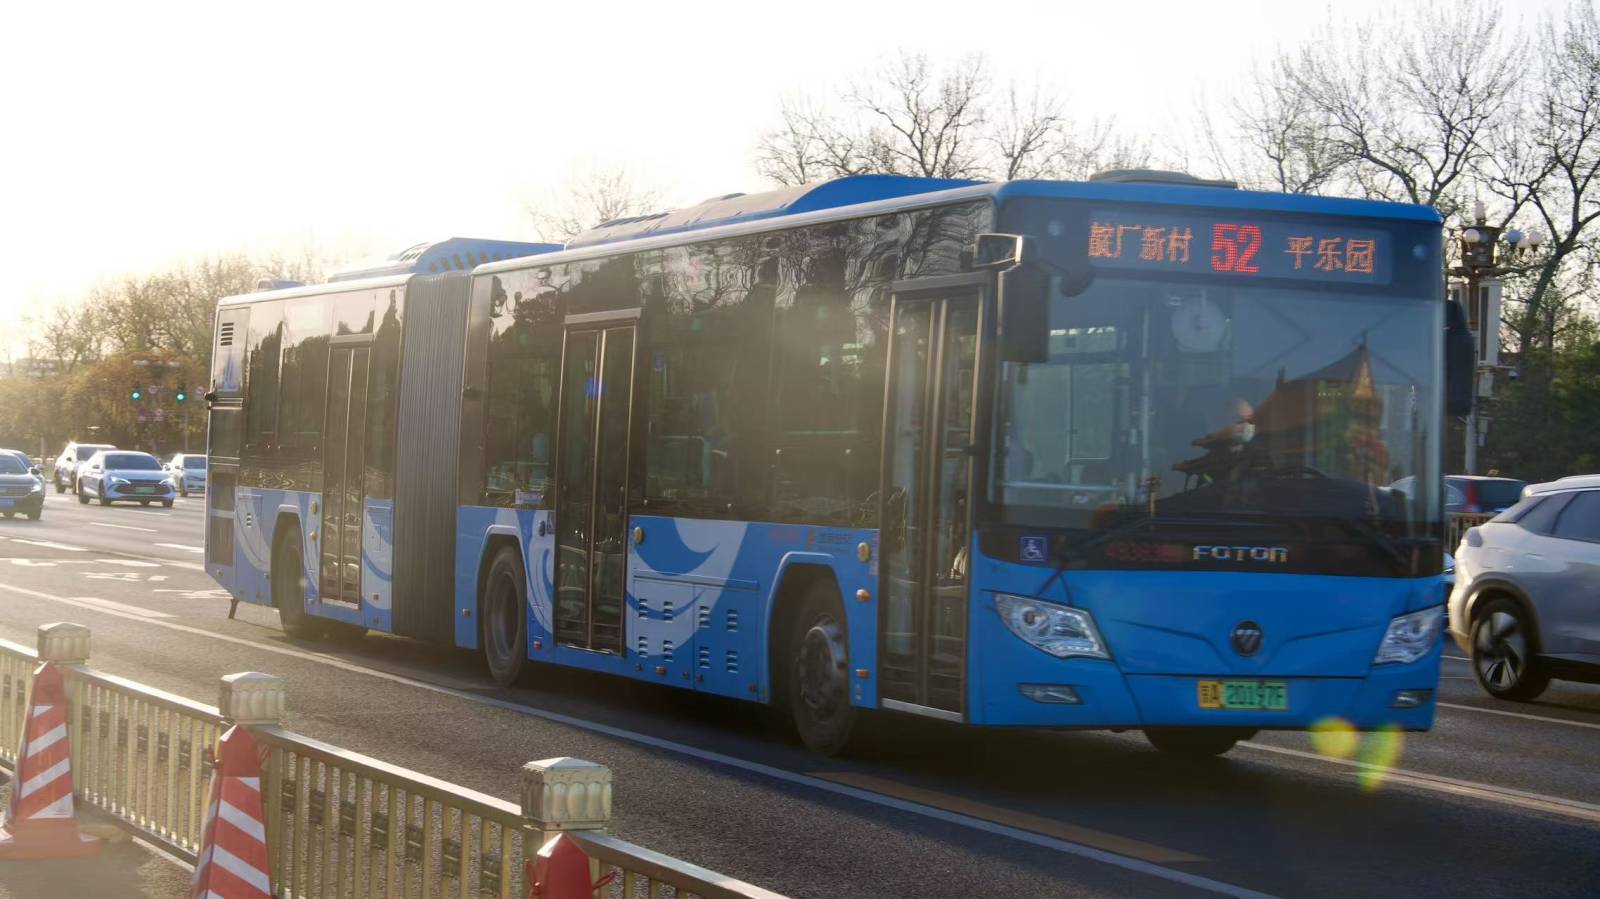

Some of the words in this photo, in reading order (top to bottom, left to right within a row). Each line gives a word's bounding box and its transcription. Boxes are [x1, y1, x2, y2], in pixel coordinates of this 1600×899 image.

[1210, 223, 1263, 273] 52
[1283, 236, 1377, 273] 平乐园
[1192, 545, 1289, 562] FOTON
